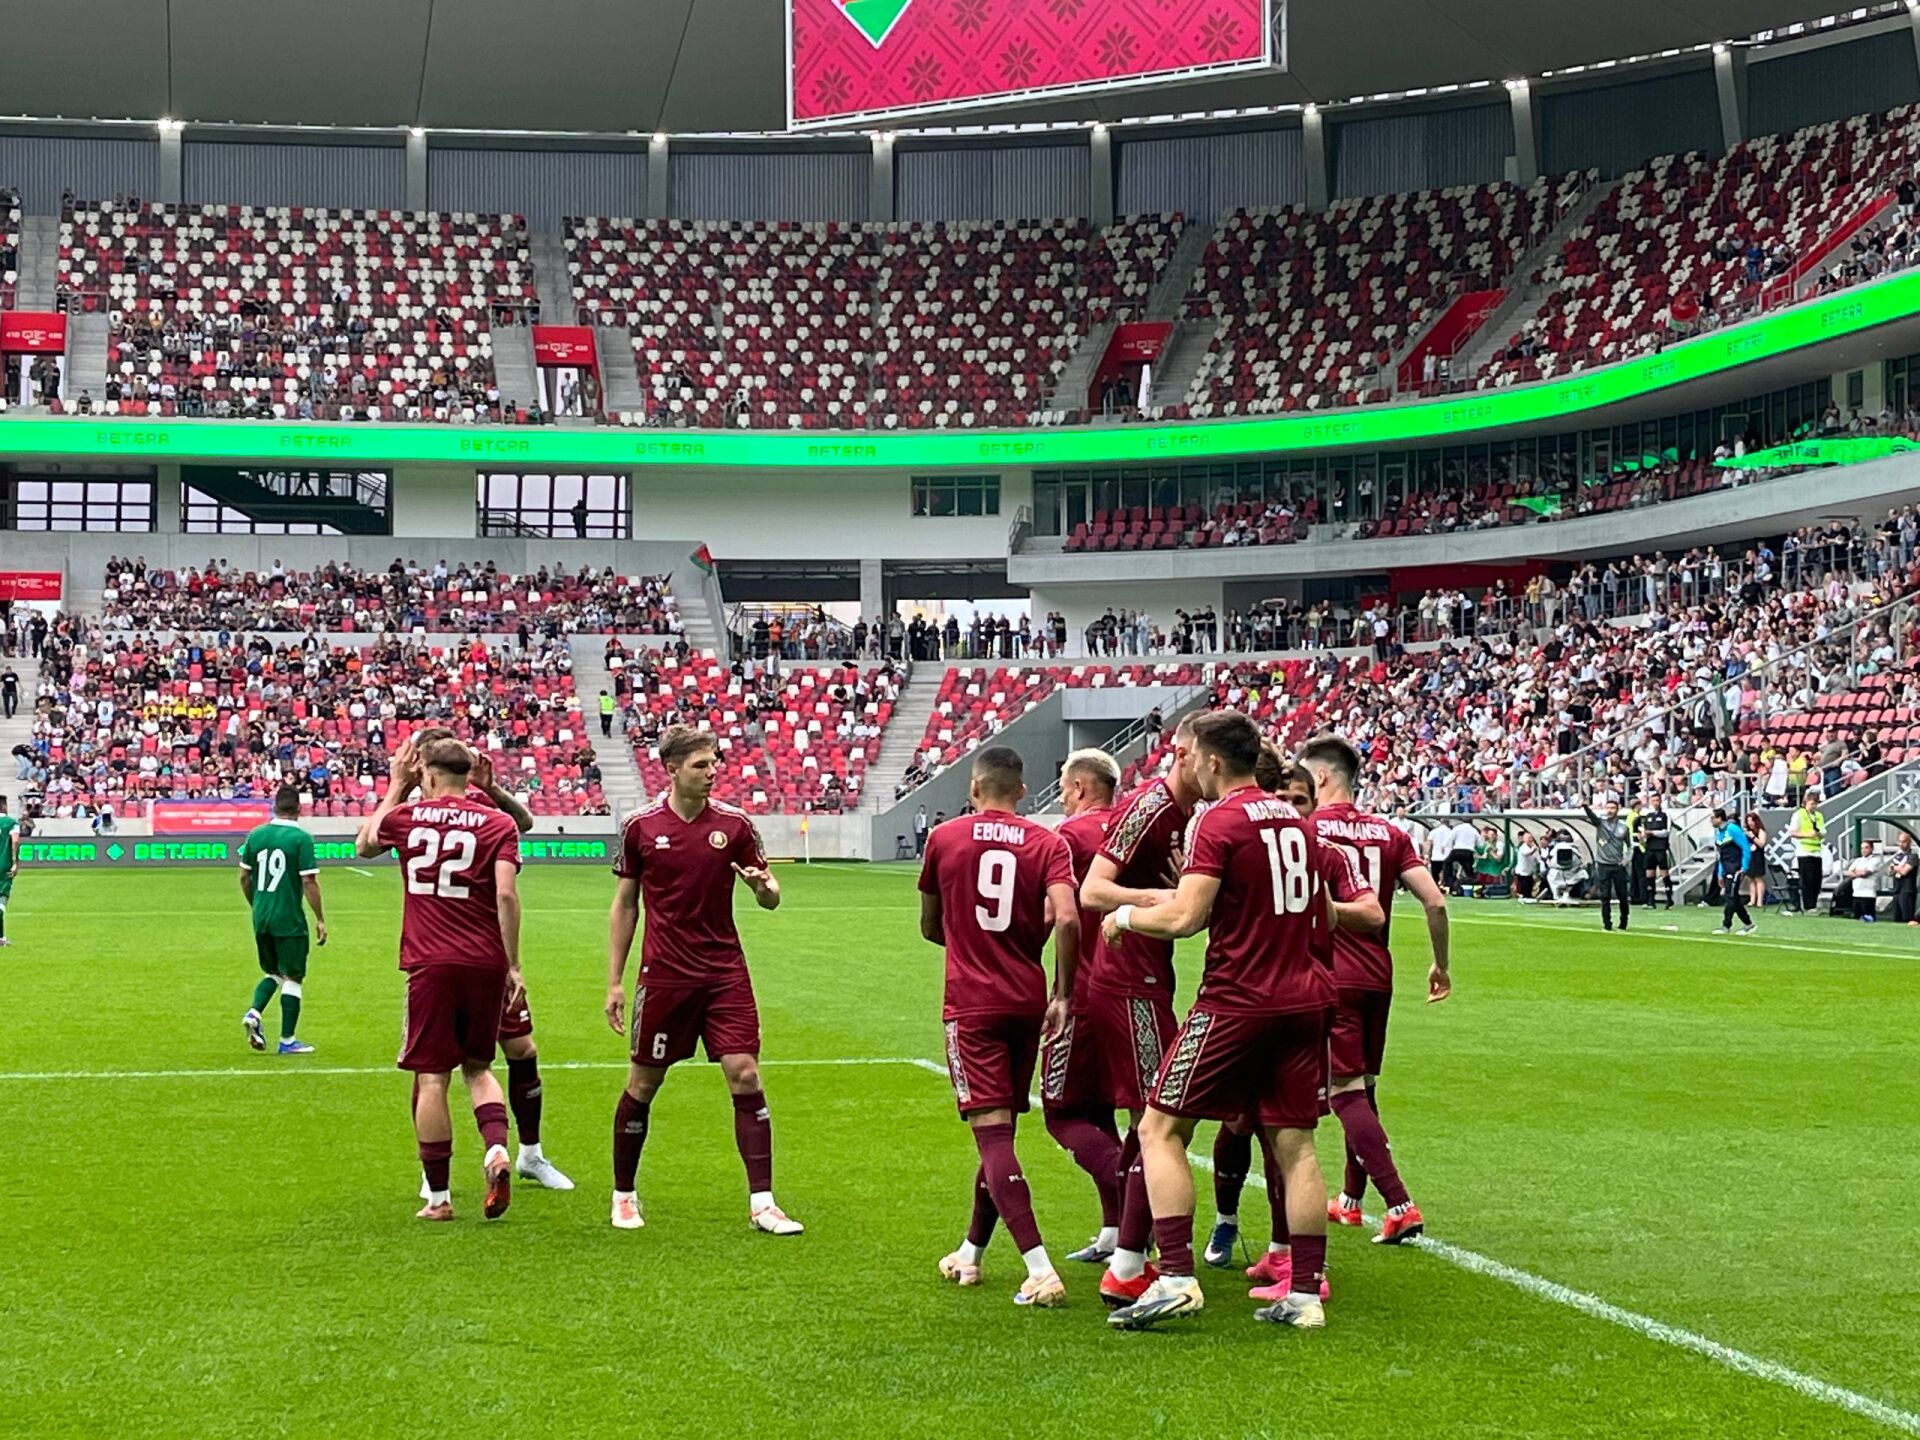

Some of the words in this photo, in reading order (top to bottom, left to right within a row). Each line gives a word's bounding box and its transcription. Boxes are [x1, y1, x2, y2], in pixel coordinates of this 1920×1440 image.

[1821, 302, 1863, 327] BETERA
[97, 432, 169, 445] BETERA
[281, 435, 351, 448] BETERA
[637, 442, 705, 456] BETERA
[412, 806, 488, 827] KANTSAVY
[972, 822, 1026, 846] EBONH
[18, 844, 97, 861] ETERA
[407, 826, 477, 898] 22
[256, 848, 286, 892] 19
[1259, 827, 1310, 915] 18
[975, 849, 1017, 932] 9
[652, 1032, 668, 1060] 6
